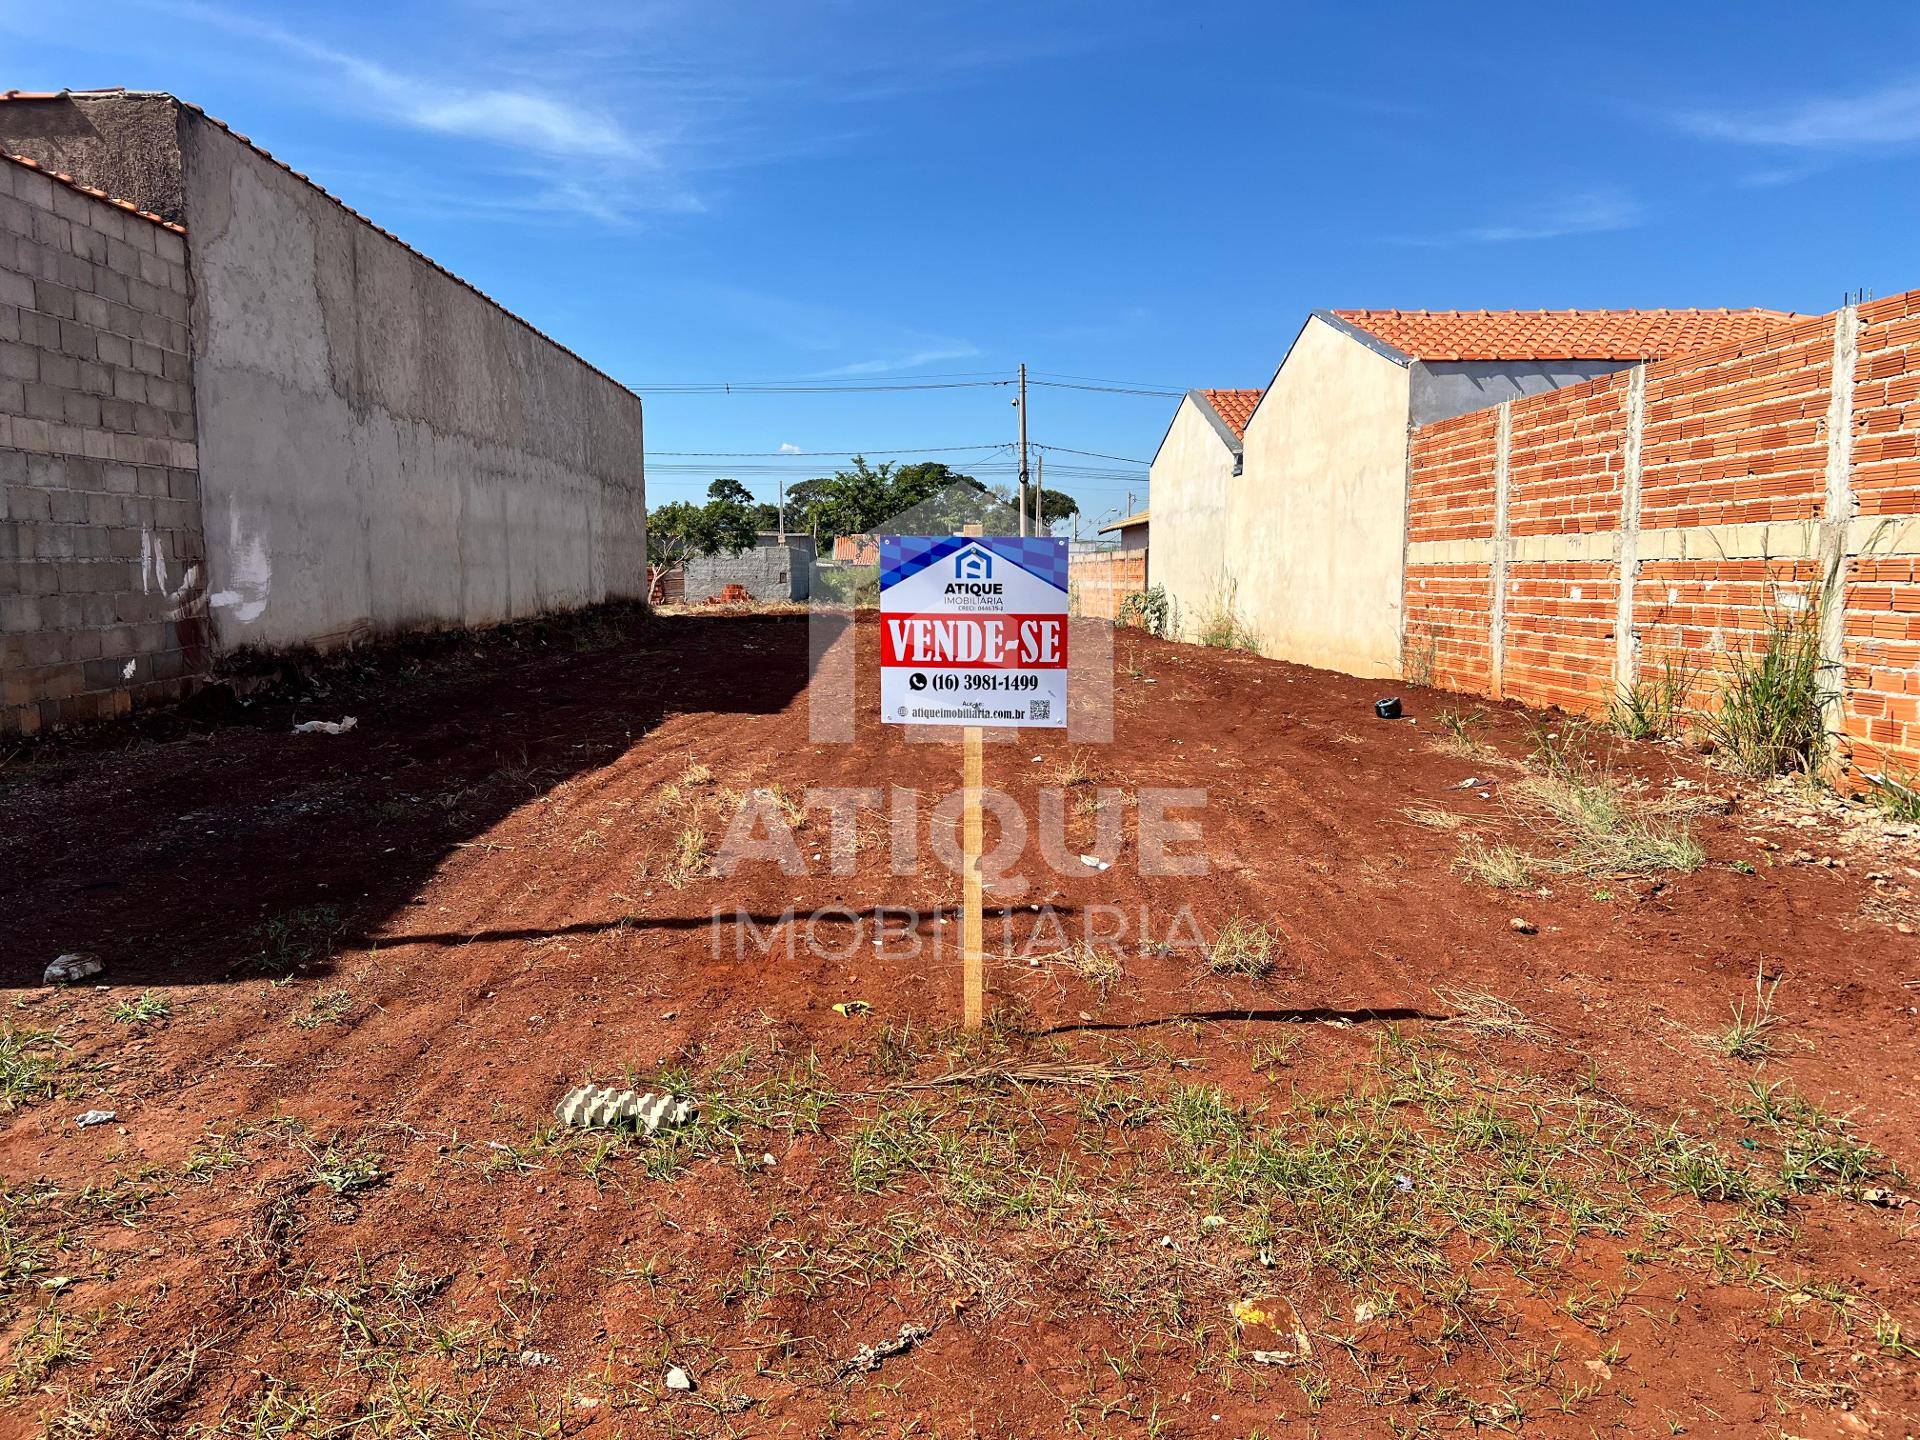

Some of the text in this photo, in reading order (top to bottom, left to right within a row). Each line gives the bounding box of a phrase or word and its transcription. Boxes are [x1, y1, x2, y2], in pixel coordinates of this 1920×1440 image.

[944, 583, 1003, 597] ATIQUE
[944, 596, 1004, 605] IMOBILIÁRIA
[888, 619, 1060, 663] VENDE-SE
[932, 674, 1039, 691] (16) 3981-1499
